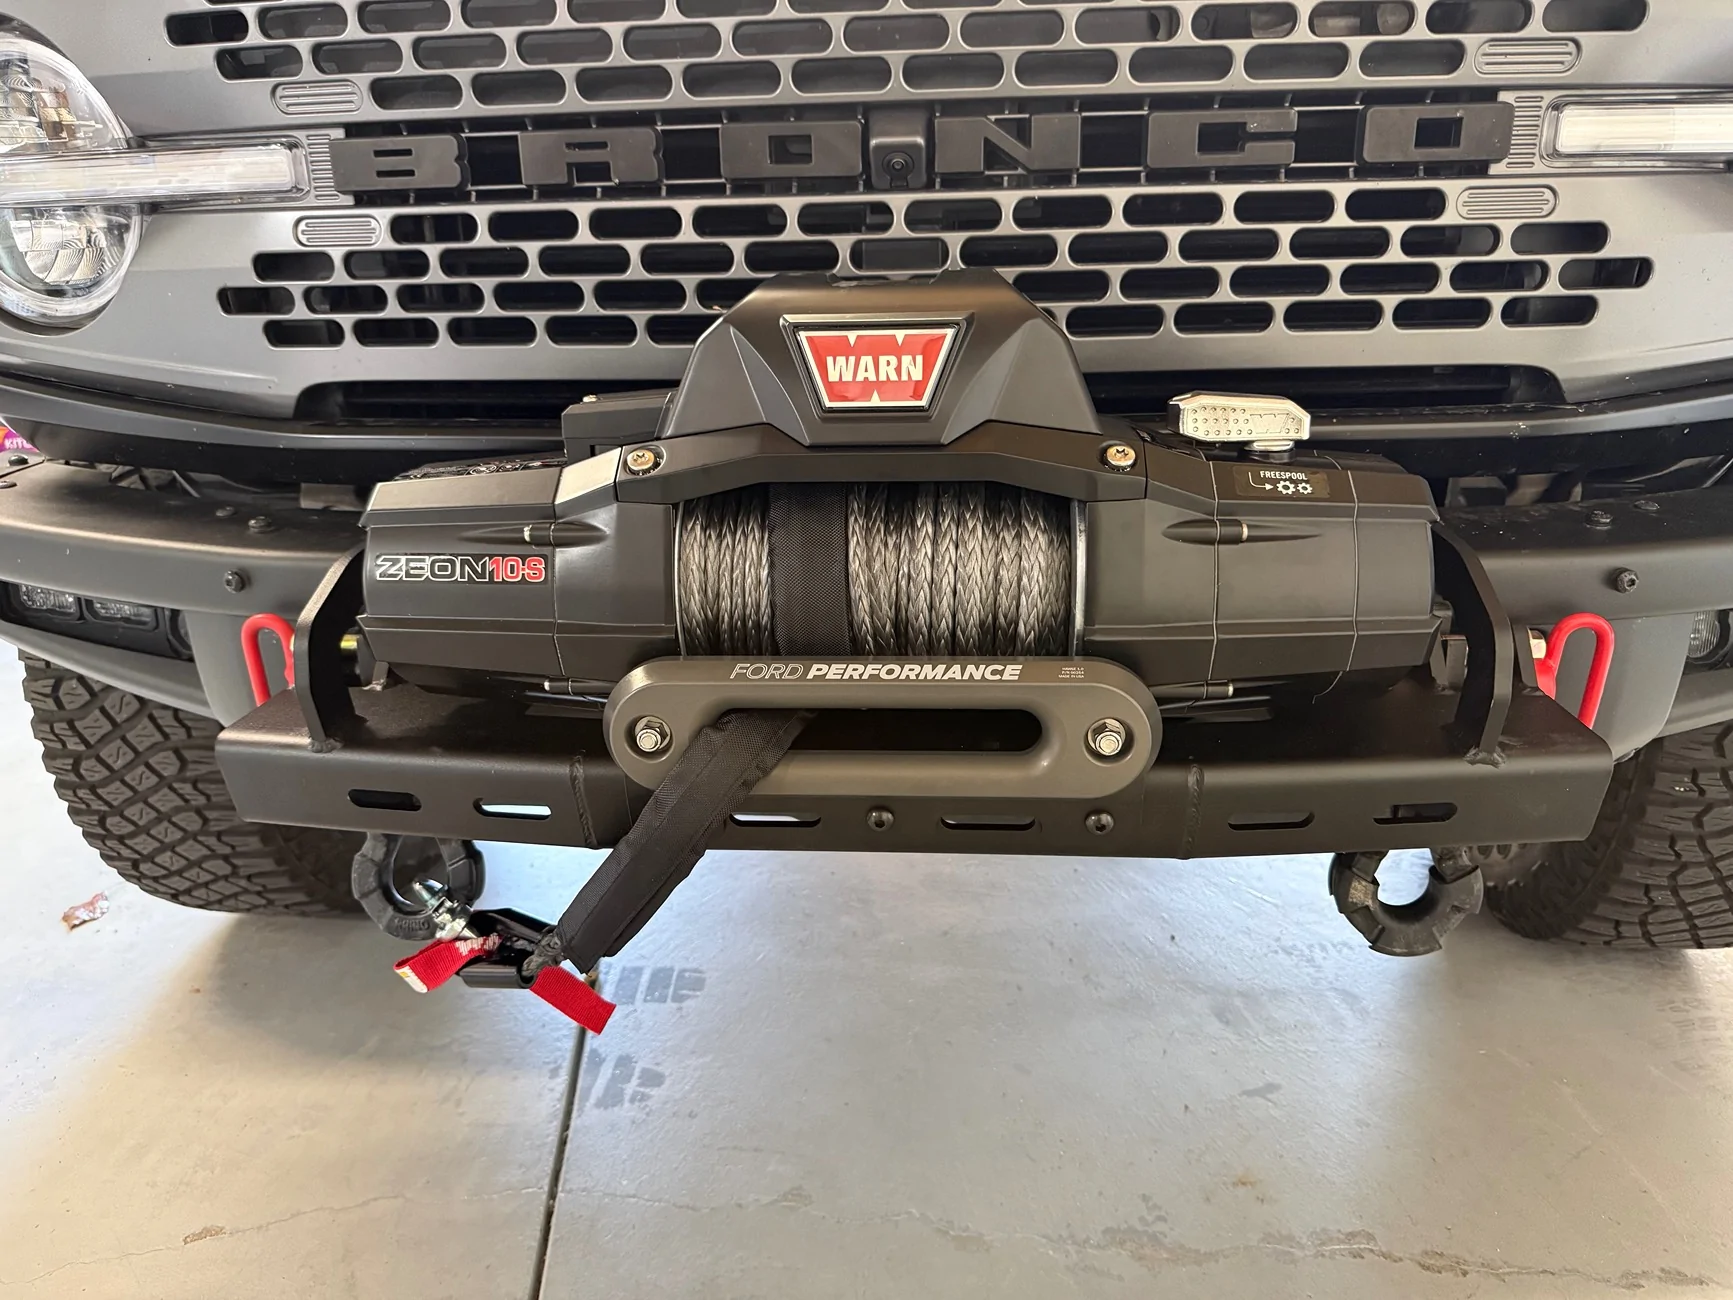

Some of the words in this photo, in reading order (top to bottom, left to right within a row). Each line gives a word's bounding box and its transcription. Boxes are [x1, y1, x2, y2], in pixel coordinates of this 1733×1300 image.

[329, 102, 1514, 193] BRONCO
[826, 354, 924, 382] WARN
[1259, 470, 1308, 481] FREESPOOL
[729, 663, 804, 680] FORD
[806, 663, 1023, 680] PERFORMANCE
